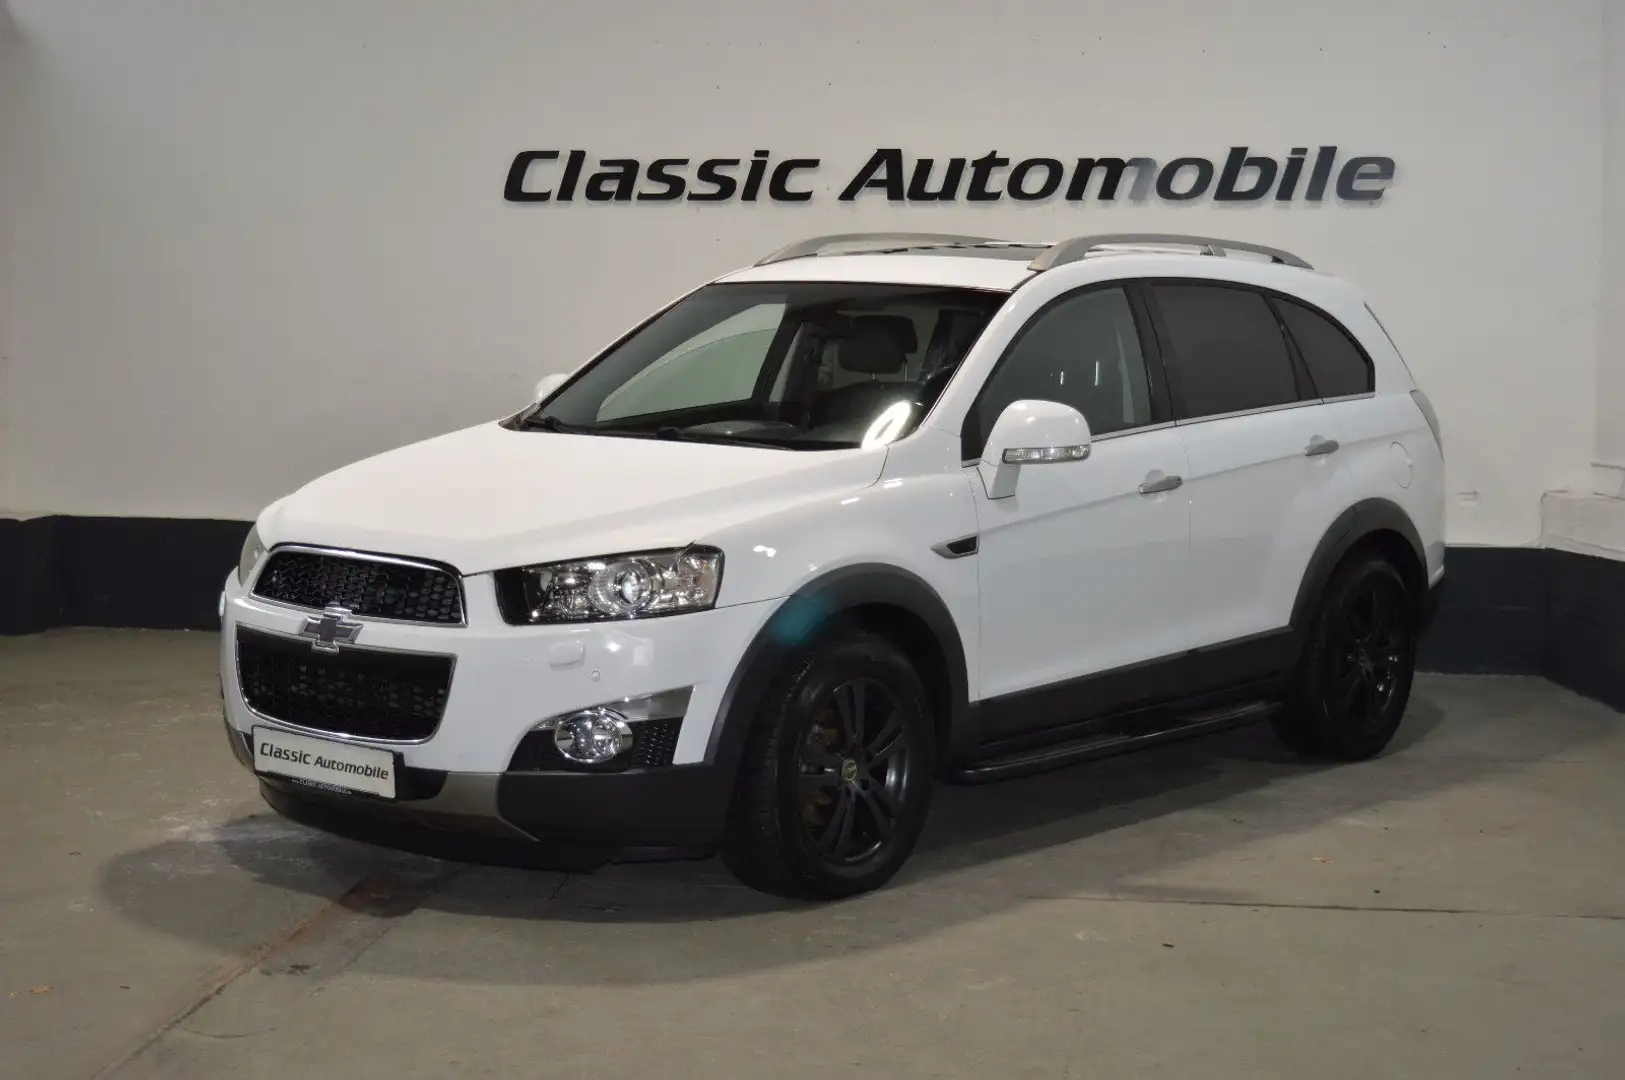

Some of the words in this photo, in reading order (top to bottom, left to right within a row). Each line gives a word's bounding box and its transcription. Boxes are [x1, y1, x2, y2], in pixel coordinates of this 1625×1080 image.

[504, 149, 820, 202] Classic
[838, 146, 1396, 202] Automobile
[260, 742, 311, 765] Classic
[314, 755, 389, 780] Automobile
